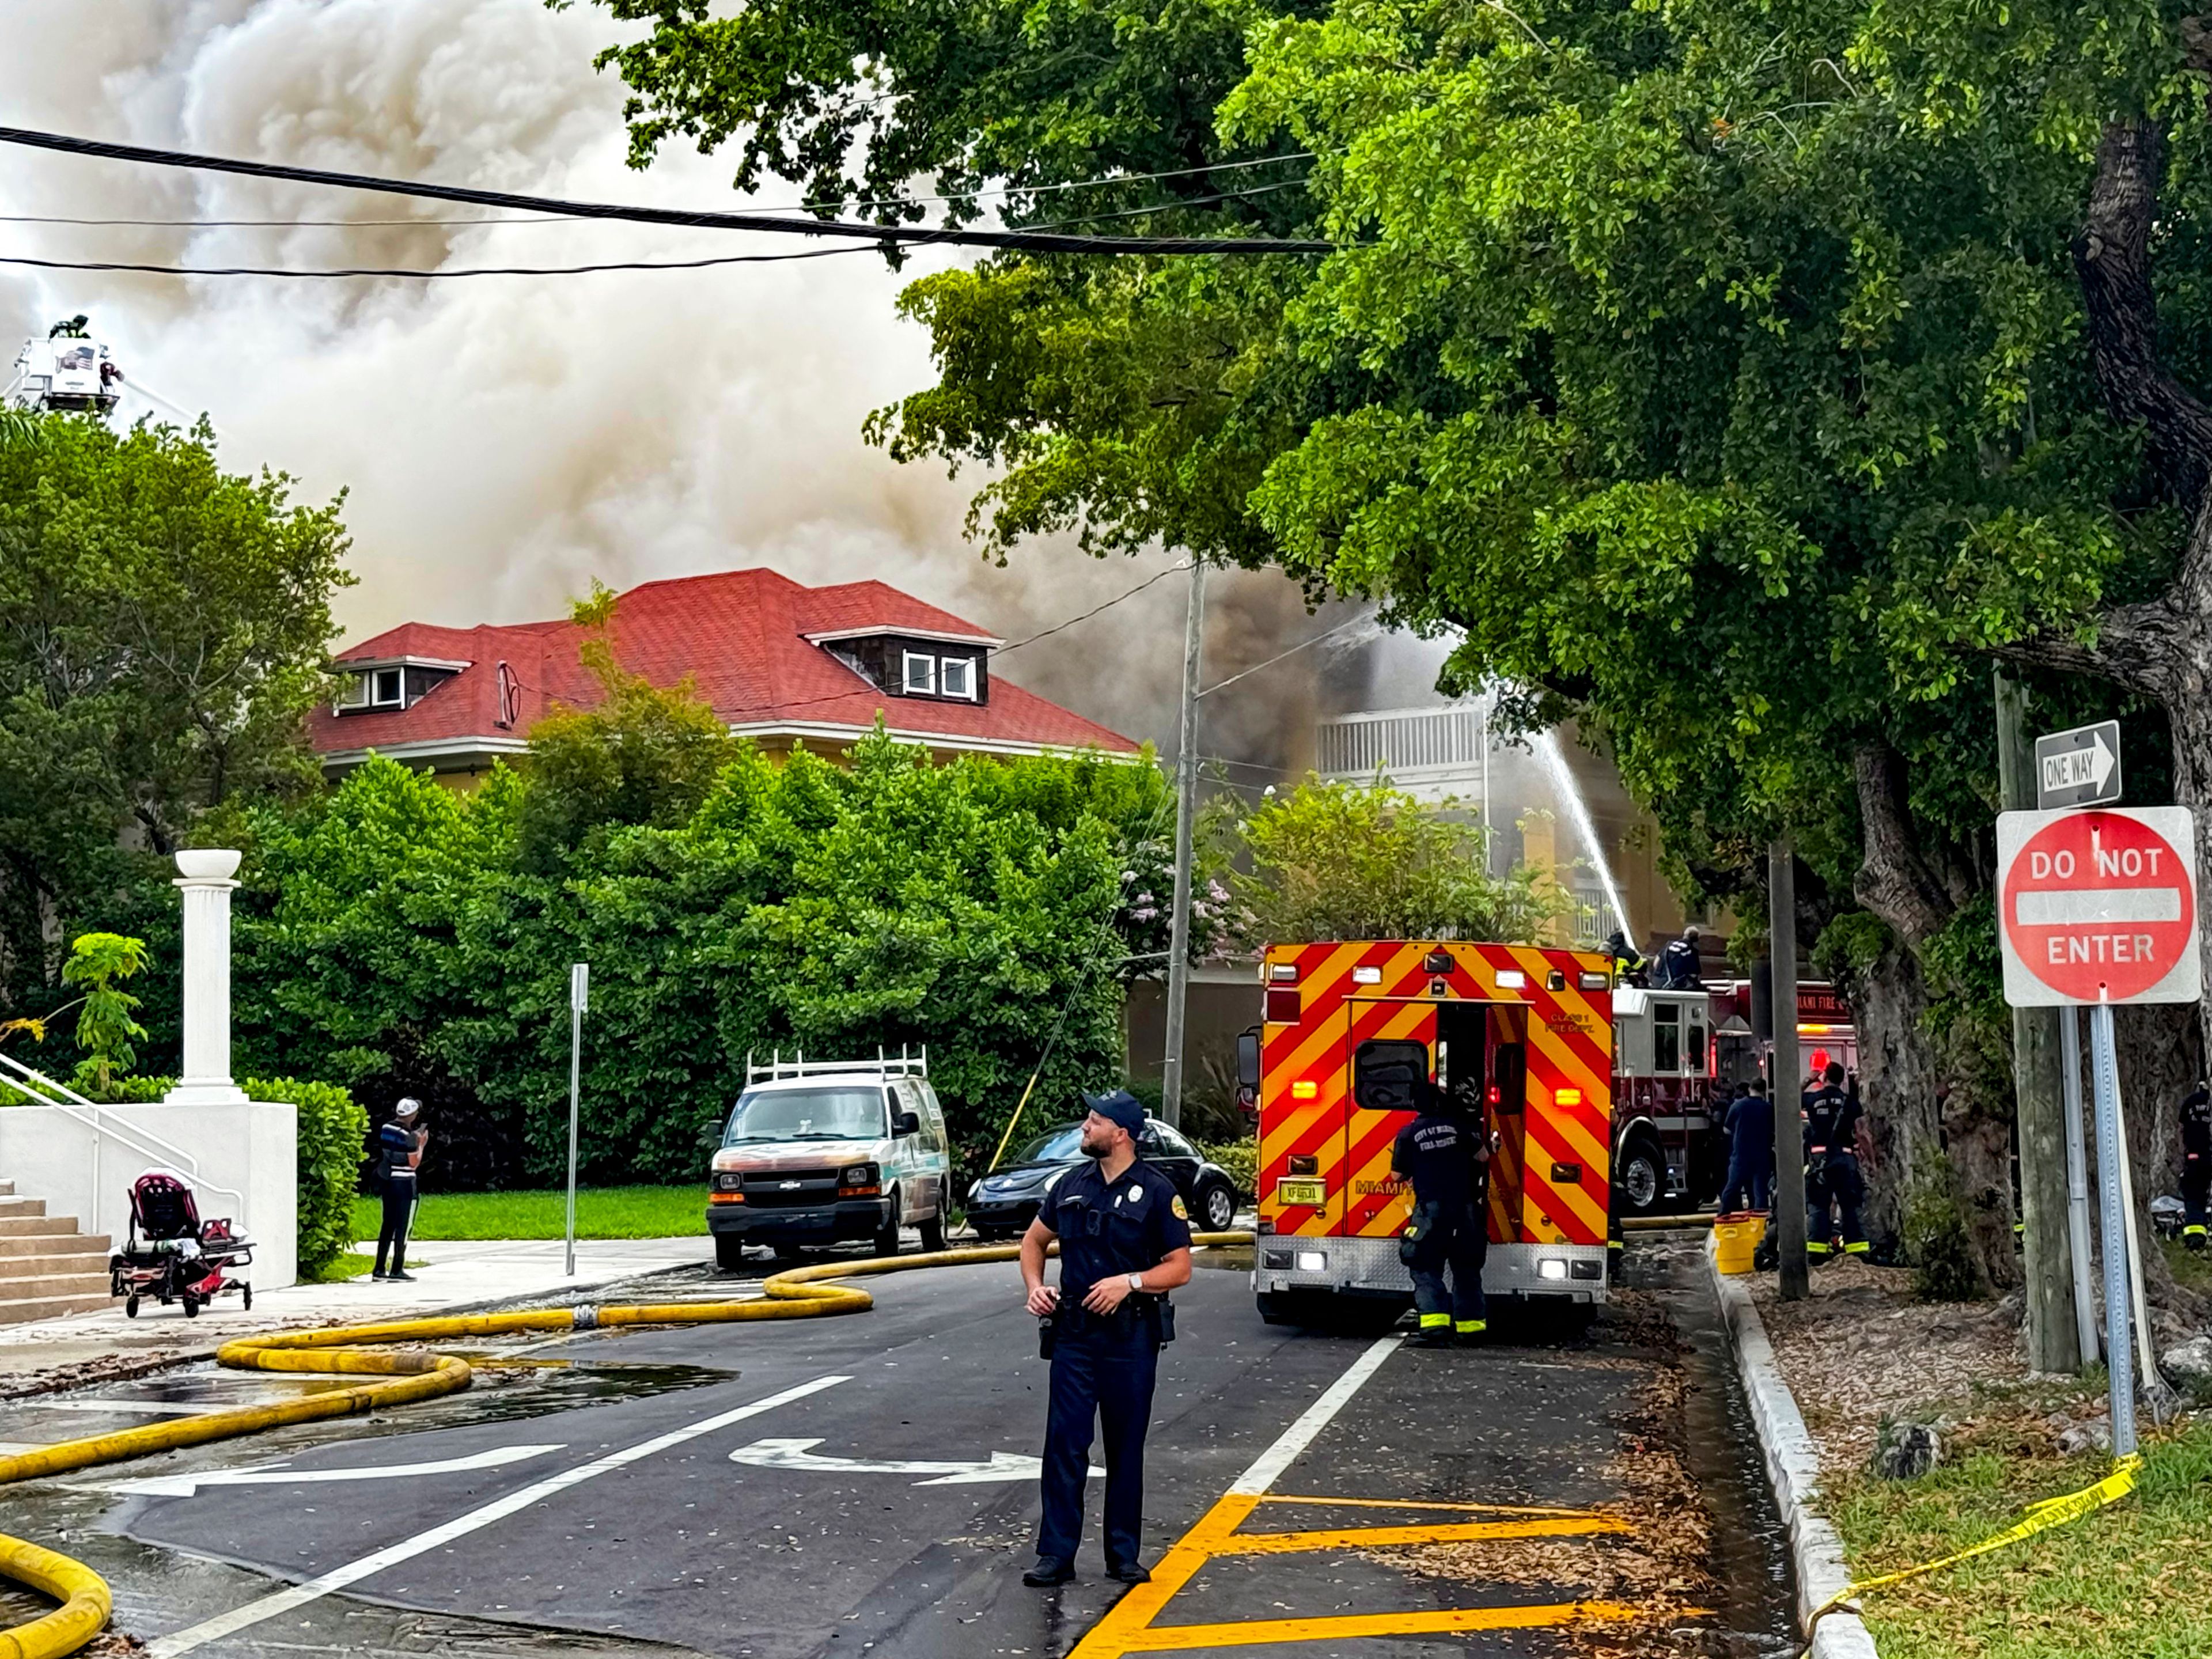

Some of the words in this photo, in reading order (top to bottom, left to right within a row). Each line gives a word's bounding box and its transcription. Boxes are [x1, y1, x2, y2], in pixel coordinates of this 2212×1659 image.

[2046, 756, 2069, 787] ONE
[2070, 751, 2093, 782] WAY
[2031, 850, 2075, 880] DO
[2099, 848, 2163, 878] NOT
[2047, 934, 2154, 964] ENTER
[1796, 996, 1816, 1009] IAMI
[1355, 1179, 1404, 1196] MIAMI
